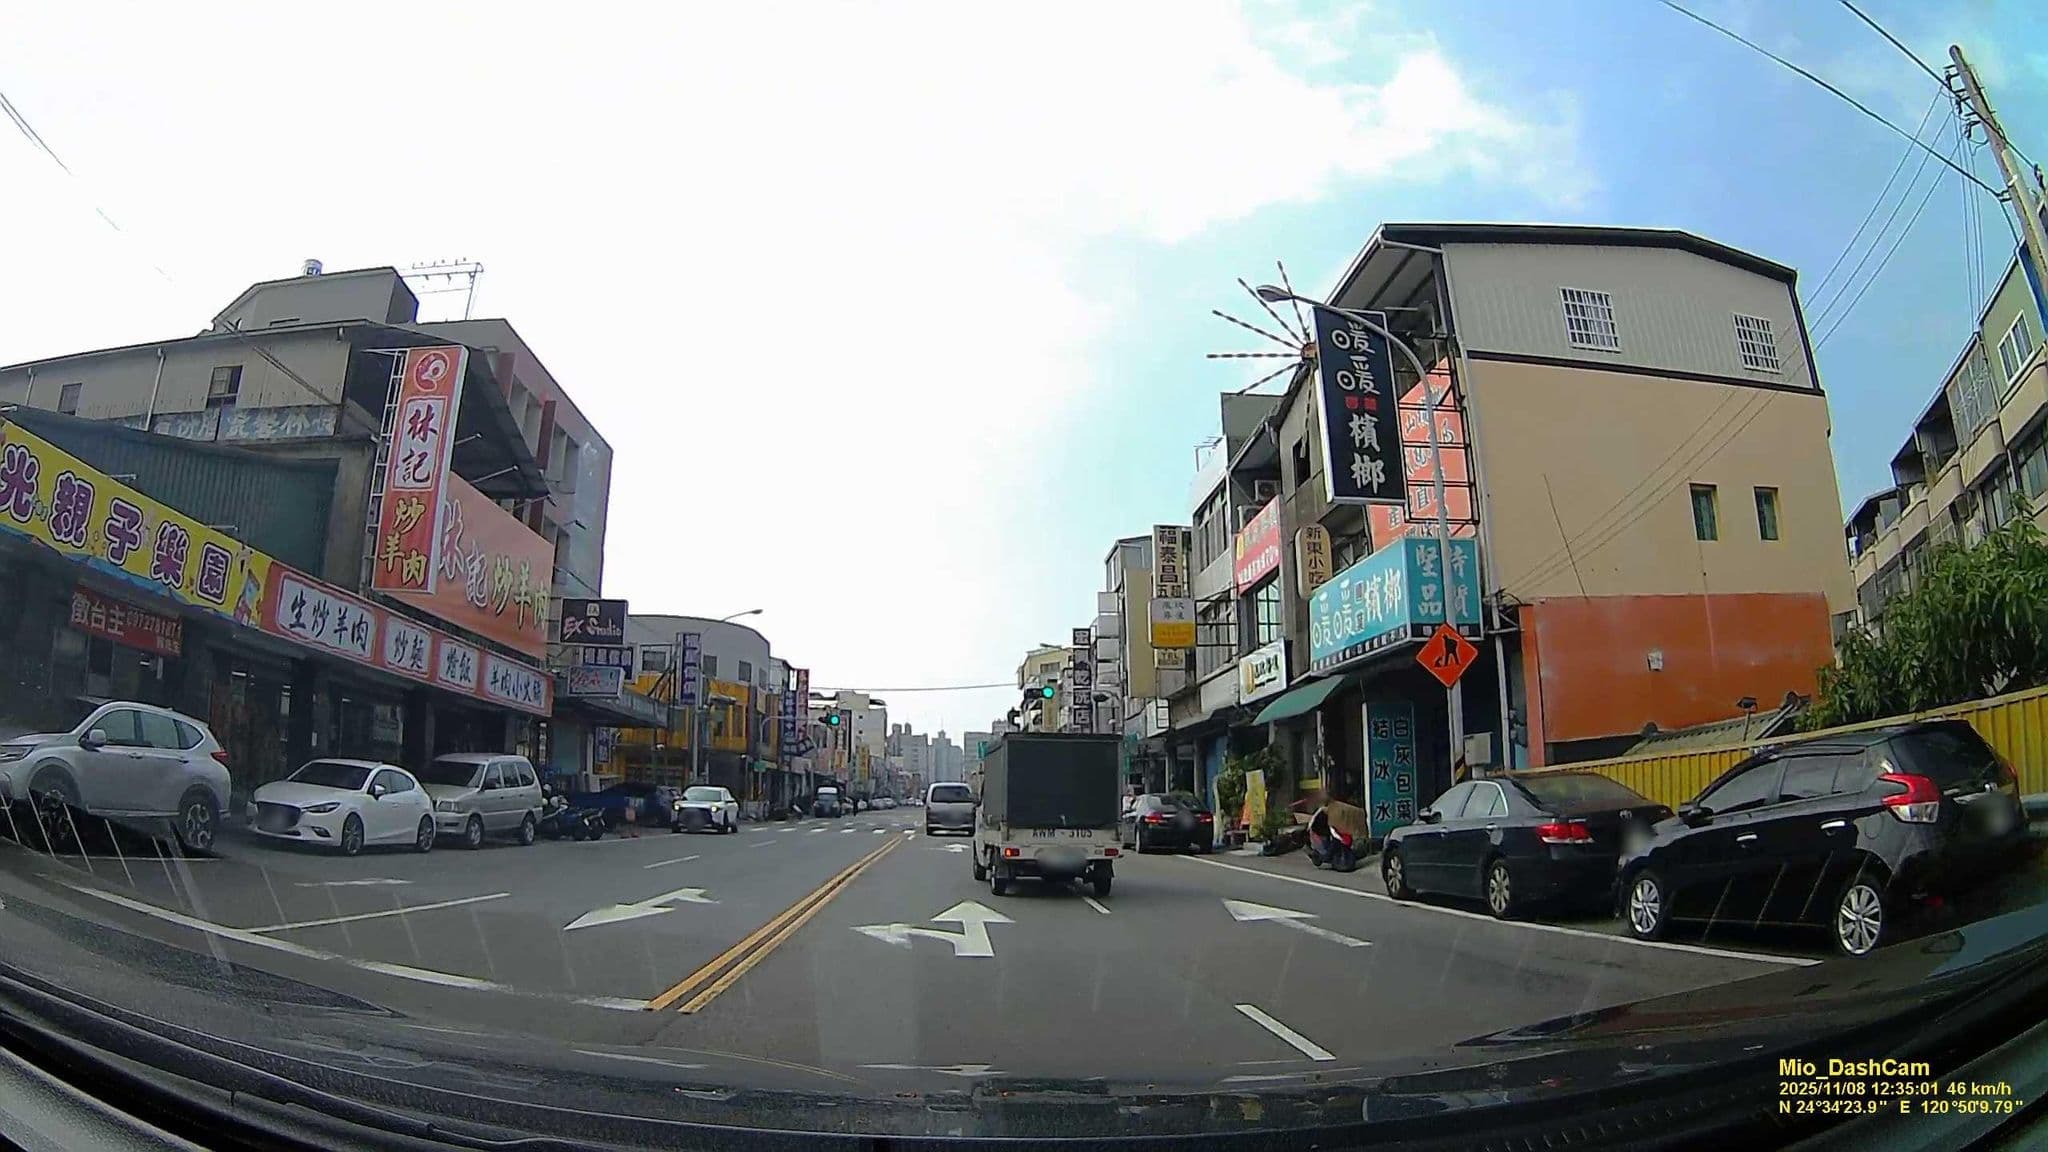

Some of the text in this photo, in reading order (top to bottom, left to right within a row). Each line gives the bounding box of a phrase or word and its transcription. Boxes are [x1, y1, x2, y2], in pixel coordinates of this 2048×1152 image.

[0, 444, 232, 605] 光親子樂園
[289, 591, 370, 650] 生炒羊肉
